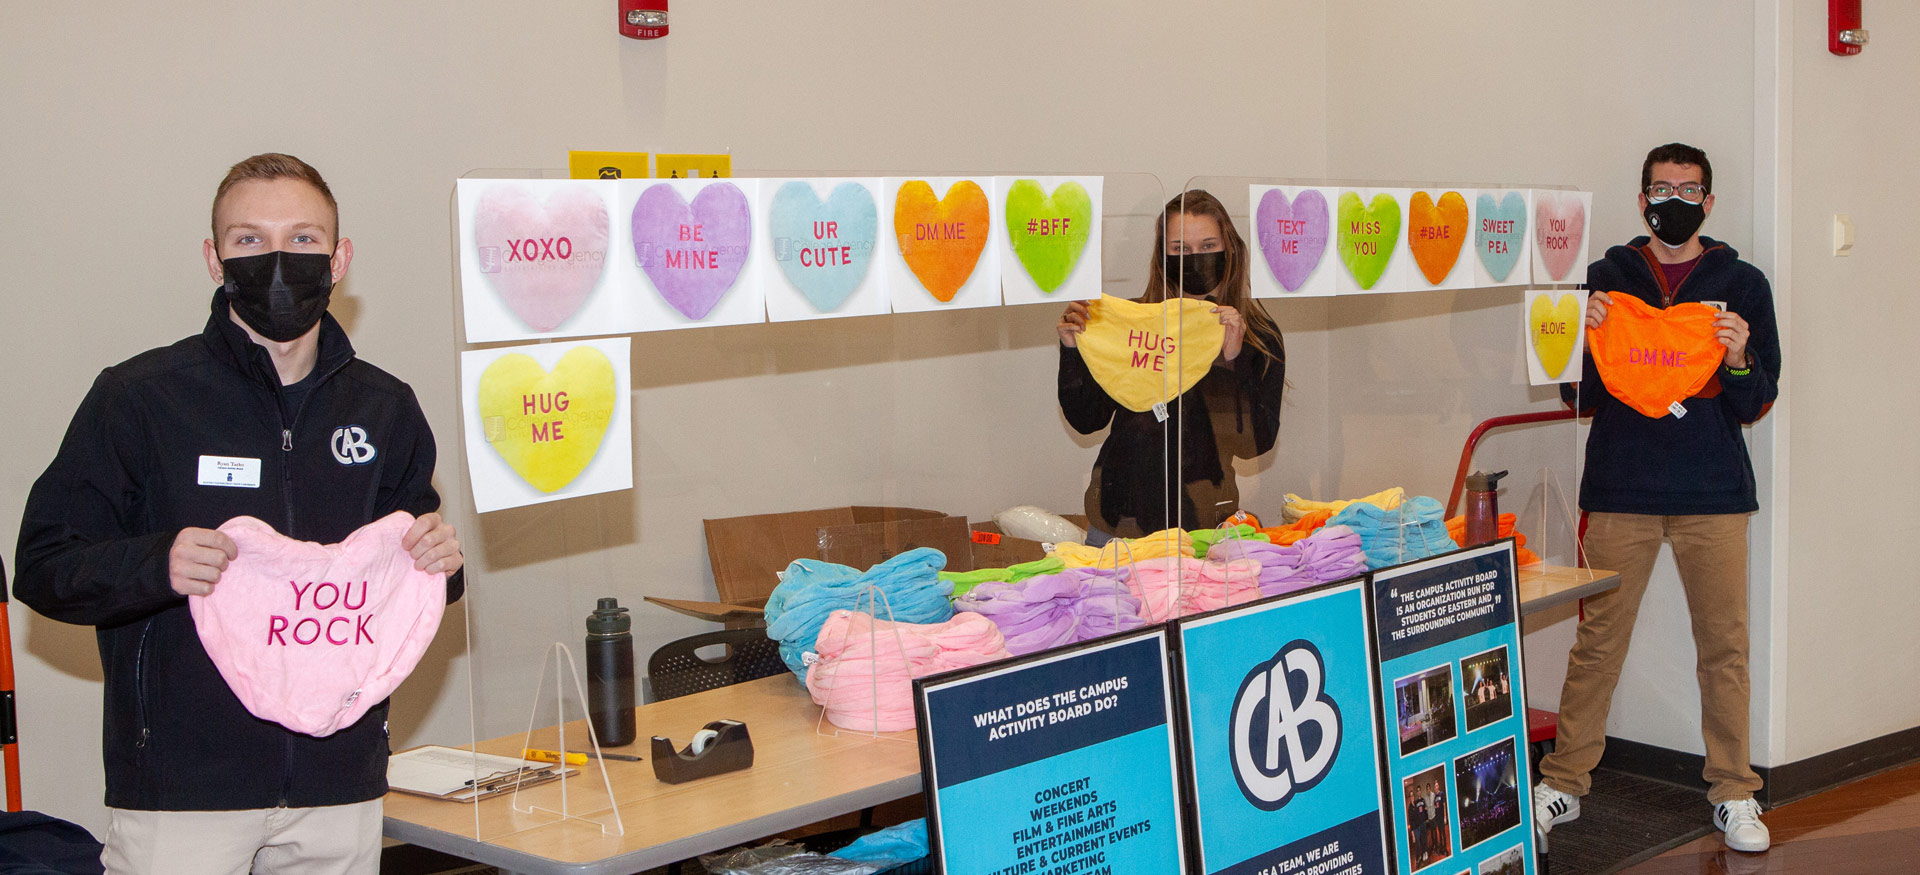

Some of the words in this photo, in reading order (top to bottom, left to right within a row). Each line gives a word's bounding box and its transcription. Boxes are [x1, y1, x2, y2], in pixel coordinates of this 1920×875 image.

[637, 29, 659, 37] FIRE
[679, 224, 704, 242] BE
[814, 221, 838, 240] UR
[916, 223, 939, 241] DM
[944, 222, 967, 240] ME
[1027, 218, 1071, 236] #BFF
[1277, 219, 1306, 235] TEXT
[1351, 221, 1381, 235] MISS
[1420, 225, 1450, 240] #BAE
[1482, 218, 1515, 234] SWEET
[1549, 218, 1566, 232] YOU
[507, 236, 572, 262] XOXO
[1281, 239, 1298, 254] ME
[1354, 242, 1377, 255] YOU
[1488, 240, 1508, 254] PEA
[1546, 236, 1569, 250] ROCK
[665, 250, 718, 269] MINE
[800, 246, 852, 267] CUTE
[1540, 322, 1566, 335] #LOVE
[1128, 329, 1176, 354] HUG
[1131, 350, 1165, 372] ME
[1629, 348, 1657, 366] DM
[1662, 350, 1687, 368] ME
[523, 391, 569, 415] HUG
[532, 421, 564, 443] ME
[331, 426, 376, 465] CAB
[290, 580, 367, 611] YOU
[1400, 591, 1415, 603] THE
[1415, 583, 1444, 599] CAMPUS
[1445, 575, 1475, 592] ACTIVITY
[1475, 570, 1498, 583] BOARD
[1396, 606, 1404, 617] IS
[1404, 602, 1415, 614] AN
[1416, 590, 1466, 610] ORGANIZATION
[1467, 586, 1481, 598] RUN
[1482, 581, 1495, 593] FOR
[1401, 608, 1437, 627] STUDENTS
[1437, 606, 1447, 616] OF
[1448, 597, 1477, 613] EASTERN
[1478, 593, 1492, 605] AND
[267, 614, 375, 646] ROCK
[1391, 628, 1406, 641] THE
[1407, 616, 1456, 637] SURROUNDING
[1456, 603, 1495, 622] COMMUNITY
[973, 707, 1014, 728] WHAT
[1016, 696, 1051, 717] DOES
[1053, 690, 1077, 707] THE
[1079, 676, 1129, 700] CAMPUS
[989, 714, 1046, 741] ACTIVITY
[1049, 702, 1092, 725] BOARD
[1095, 695, 1118, 713] DO?
[1234, 648, 1339, 802] CAB
[1034, 777, 1090, 804] CONCERT
[1030, 790, 1098, 822] WEEKENDS
[1013, 825, 1042, 844] FILM
[1045, 822, 1054, 834] &
[1057, 812, 1084, 830] FINE
[1087, 800, 1117, 820] ARTS
[1016, 816, 1116, 859] ENTERTAINMENT
[1039, 856, 1048, 868] &
[1051, 835, 1106, 864] CURRENT
[1108, 819, 1151, 845] EVENTS
[1036, 851, 1106, 875] ARKETING
[1271, 866, 1278, 875] A
[1278, 855, 1306, 874] TEAM,
[1306, 848, 1321, 863] WE
[1322, 841, 1339, 857] ARE
[1307, 851, 1354, 875] PROVIDING
